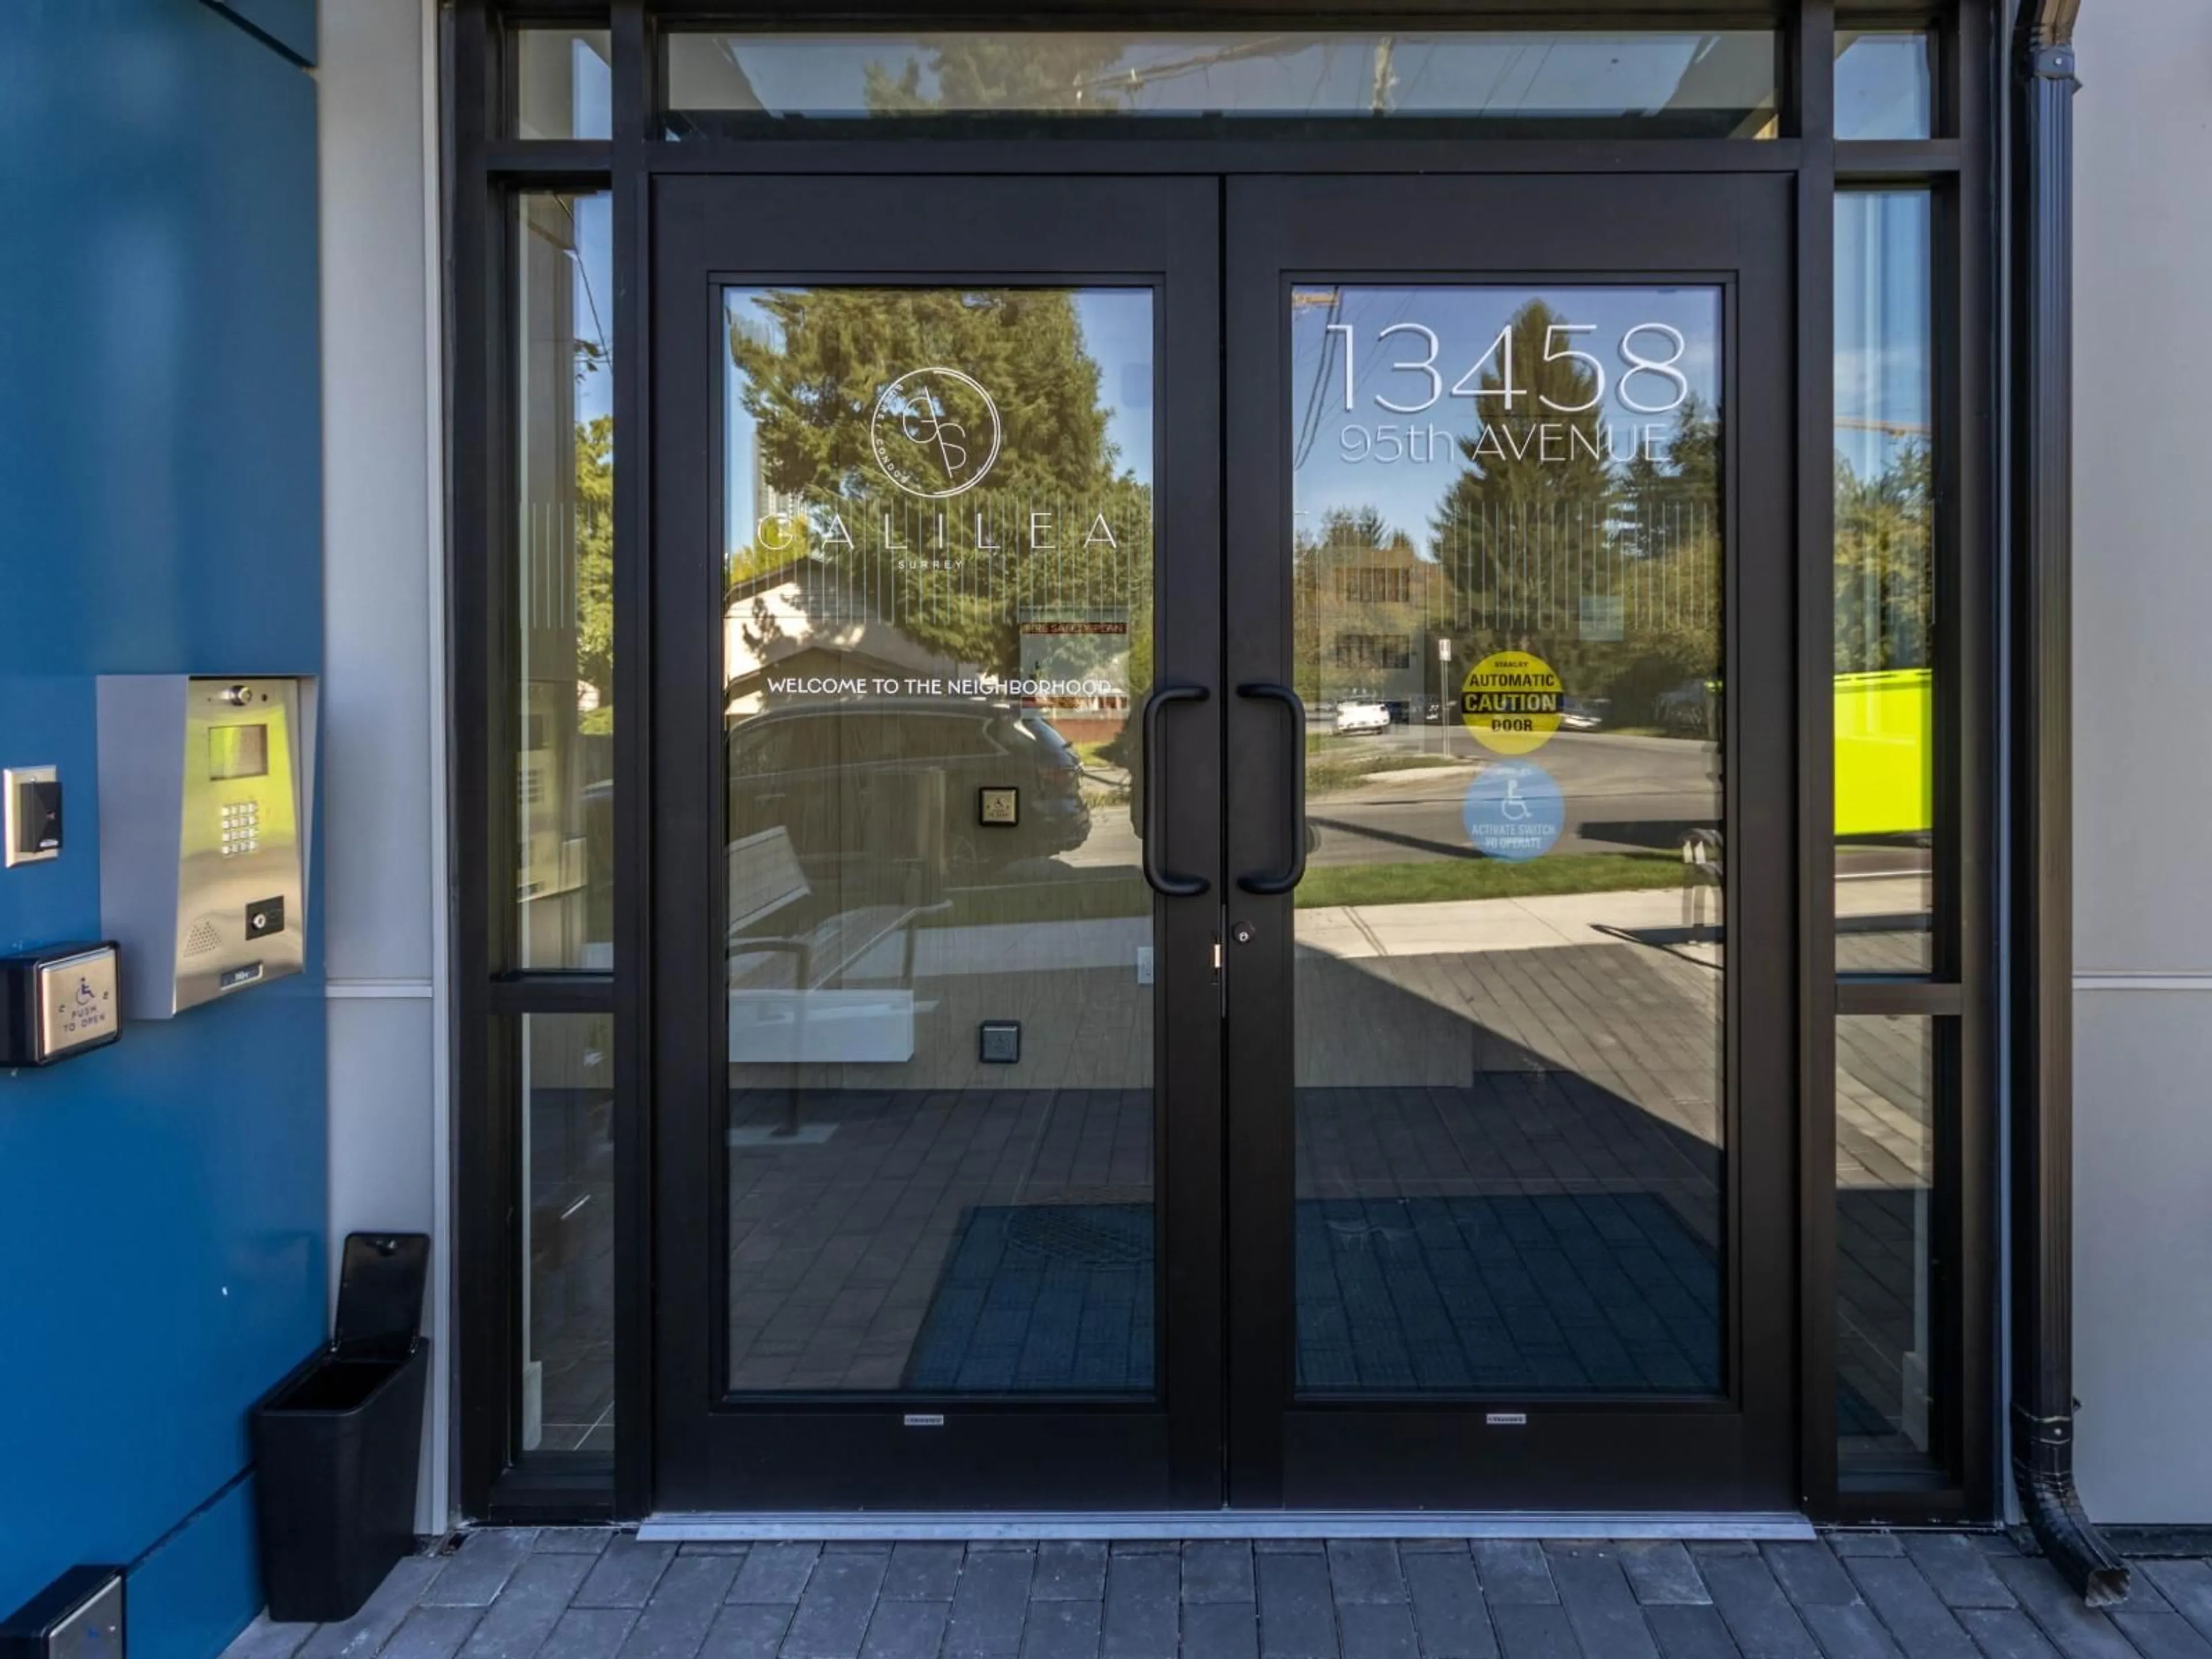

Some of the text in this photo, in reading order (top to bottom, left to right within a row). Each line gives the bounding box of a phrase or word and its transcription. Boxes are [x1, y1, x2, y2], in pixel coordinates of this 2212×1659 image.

[1326, 323, 1688, 412] 13458
[1339, 422, 1671, 463] 95th AVENUE
[757, 513, 1116, 549] GALILEA
[897, 560, 962, 569] SURREY
[767, 677, 1111, 695] WELCOME TO THE NEIGHBORHOOD
[1469, 674, 1555, 687] AUTOMATIC
[1465, 693, 1557, 711] CAUTION
[1491, 719, 1533, 732] DOOR
[1472, 823, 1555, 836] ACTIVATE SWITCH
[1485, 836, 1541, 849] TO OPERATE
[71, 1005, 97, 1018] PUSH
[63, 1014, 105, 1033] TO OPEN
